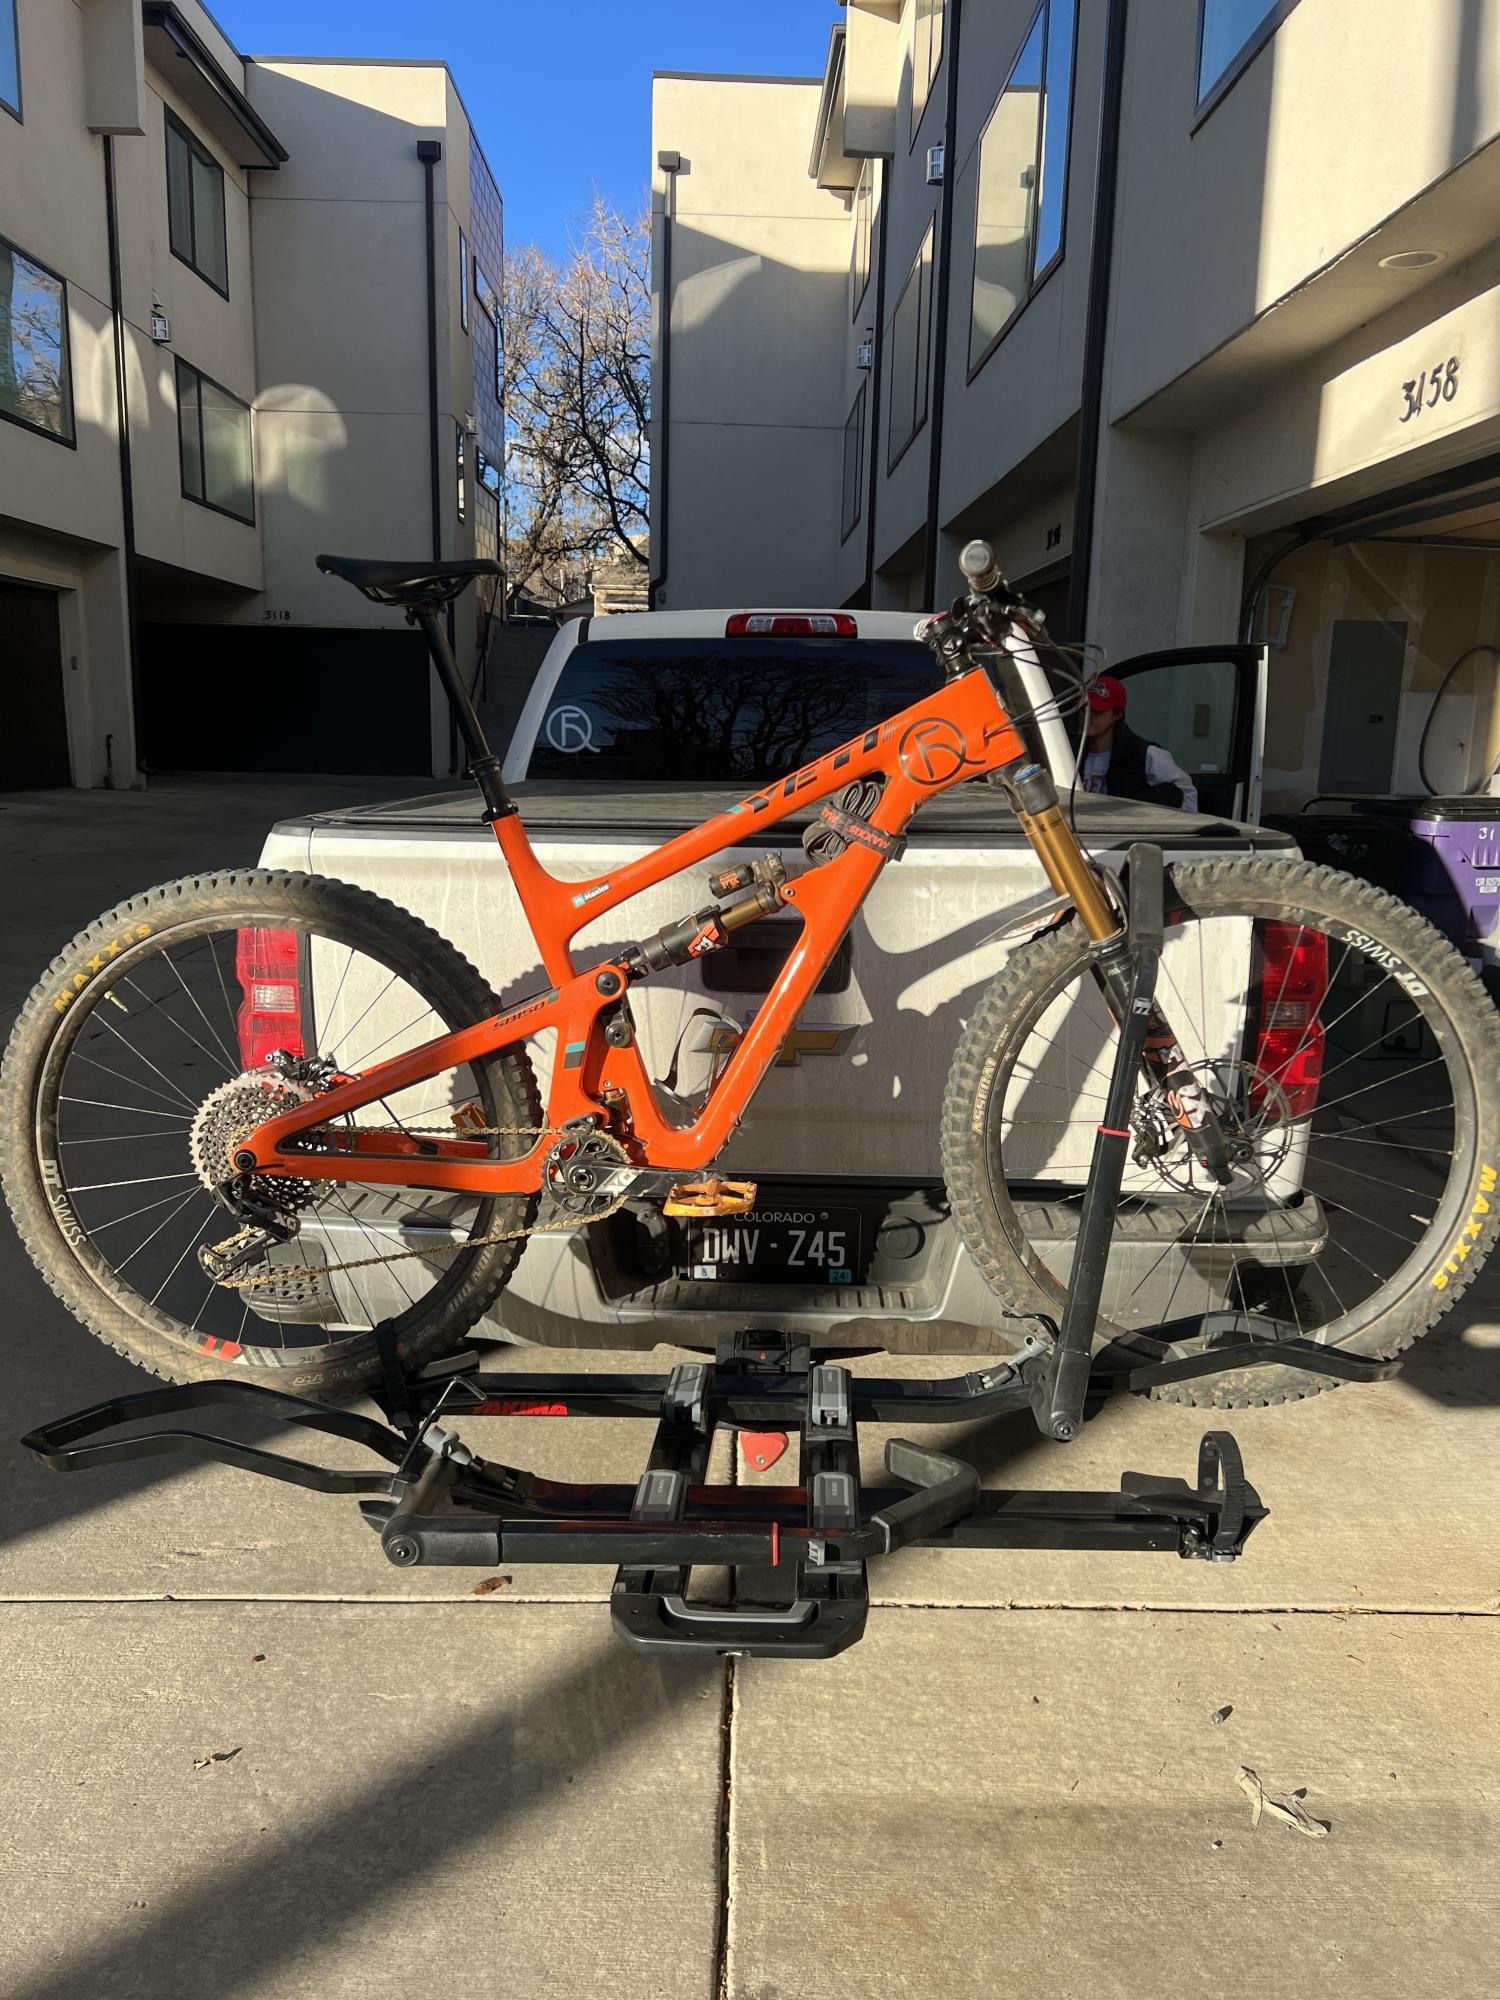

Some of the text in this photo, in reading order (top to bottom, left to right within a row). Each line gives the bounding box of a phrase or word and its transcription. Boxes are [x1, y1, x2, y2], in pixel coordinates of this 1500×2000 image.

[1398, 355, 1460, 423] 3158
[848, 823, 891, 850] MAXXIS
[54, 923, 152, 1014] MAXXIS
[1341, 929, 1430, 997] DT SWISS
[41, 1159, 87, 1246] DT SWISS
[734, 1211, 815, 1224] COLORADO
[1430, 1163, 1498, 1291] MAXXIS
[702, 1227, 760, 1265] DWV
[787, 1230, 846, 1267] Z45
[832, 1271, 846, 1281] 24
